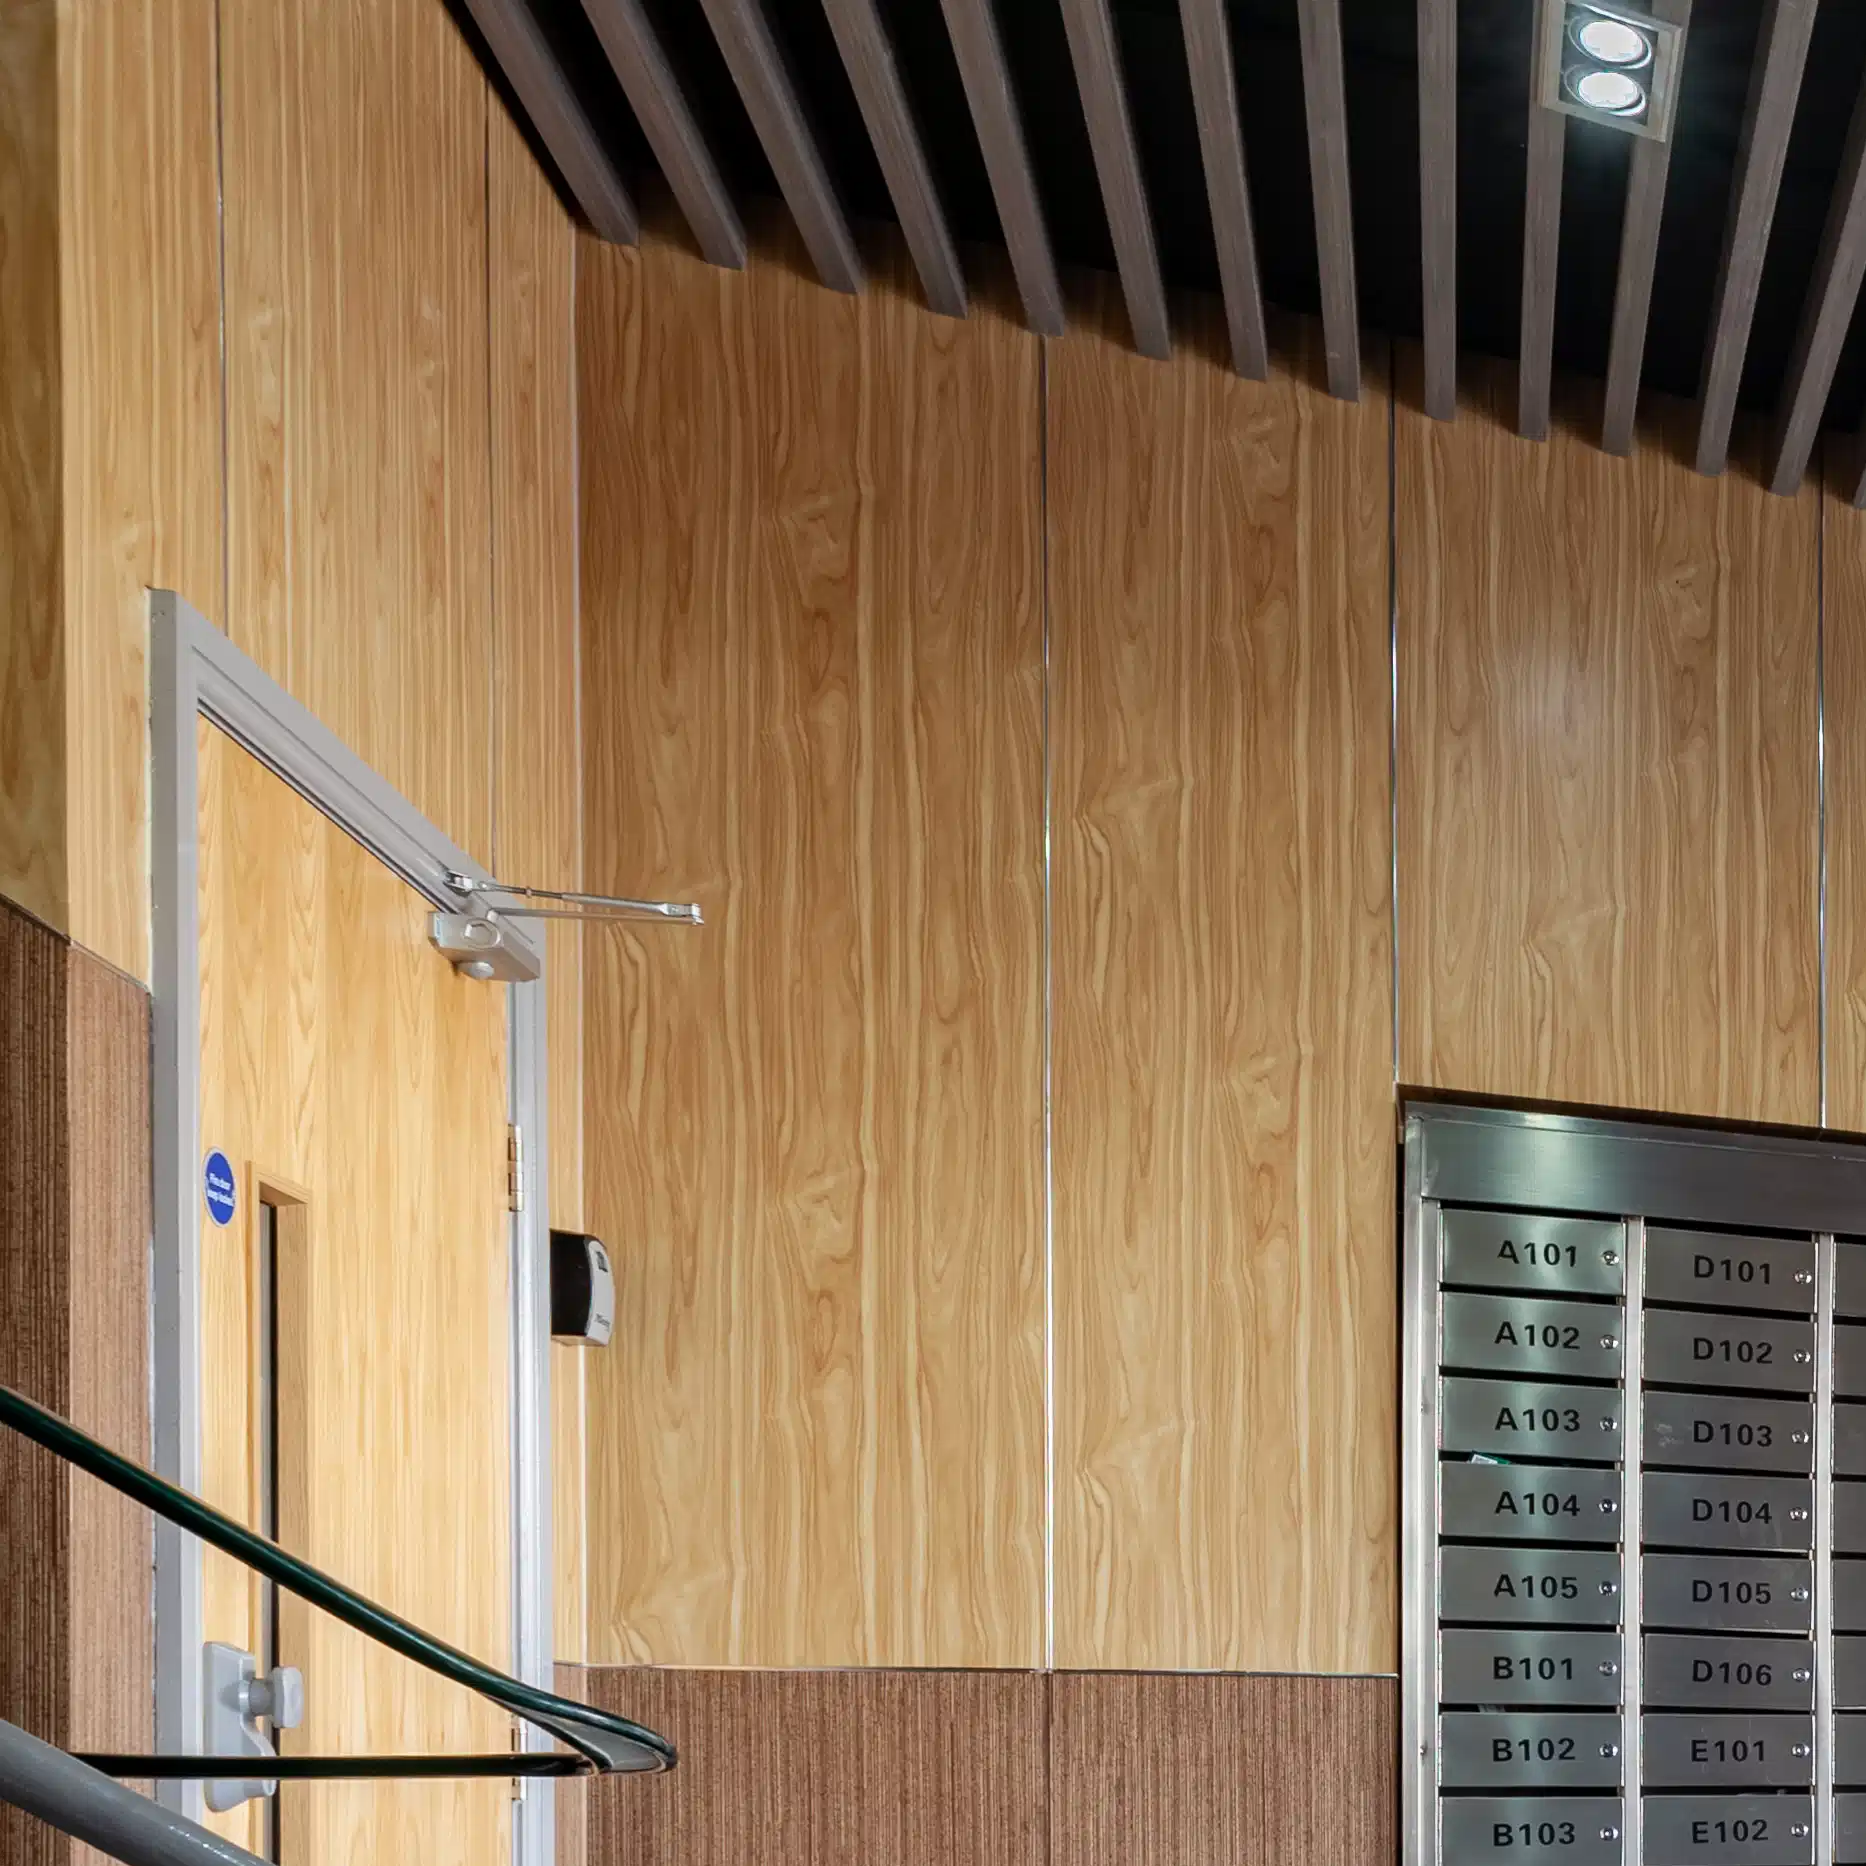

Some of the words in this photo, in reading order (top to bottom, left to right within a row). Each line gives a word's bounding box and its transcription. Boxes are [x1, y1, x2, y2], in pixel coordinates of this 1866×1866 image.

[1496, 1239, 1577, 1268] A101
[1693, 1254, 1770, 1285] D101
[1493, 1320, 1581, 1350] A102
[1693, 1337, 1773, 1365] D102
[1494, 1406, 1581, 1433] A103
[1693, 1420, 1773, 1448] D103
[1494, 1490, 1581, 1517] A104
[1692, 1498, 1773, 1525] D104
[1493, 1573, 1579, 1600] A105
[1691, 1579, 1772, 1605] D105
[1493, 1655, 1573, 1681] B101
[1691, 1659, 1772, 1686] D106
[1491, 1737, 1576, 1763] B102
[1691, 1739, 1765, 1763] E101
[1492, 1821, 1576, 1847] B103
[1691, 1819, 1769, 1845] E102
